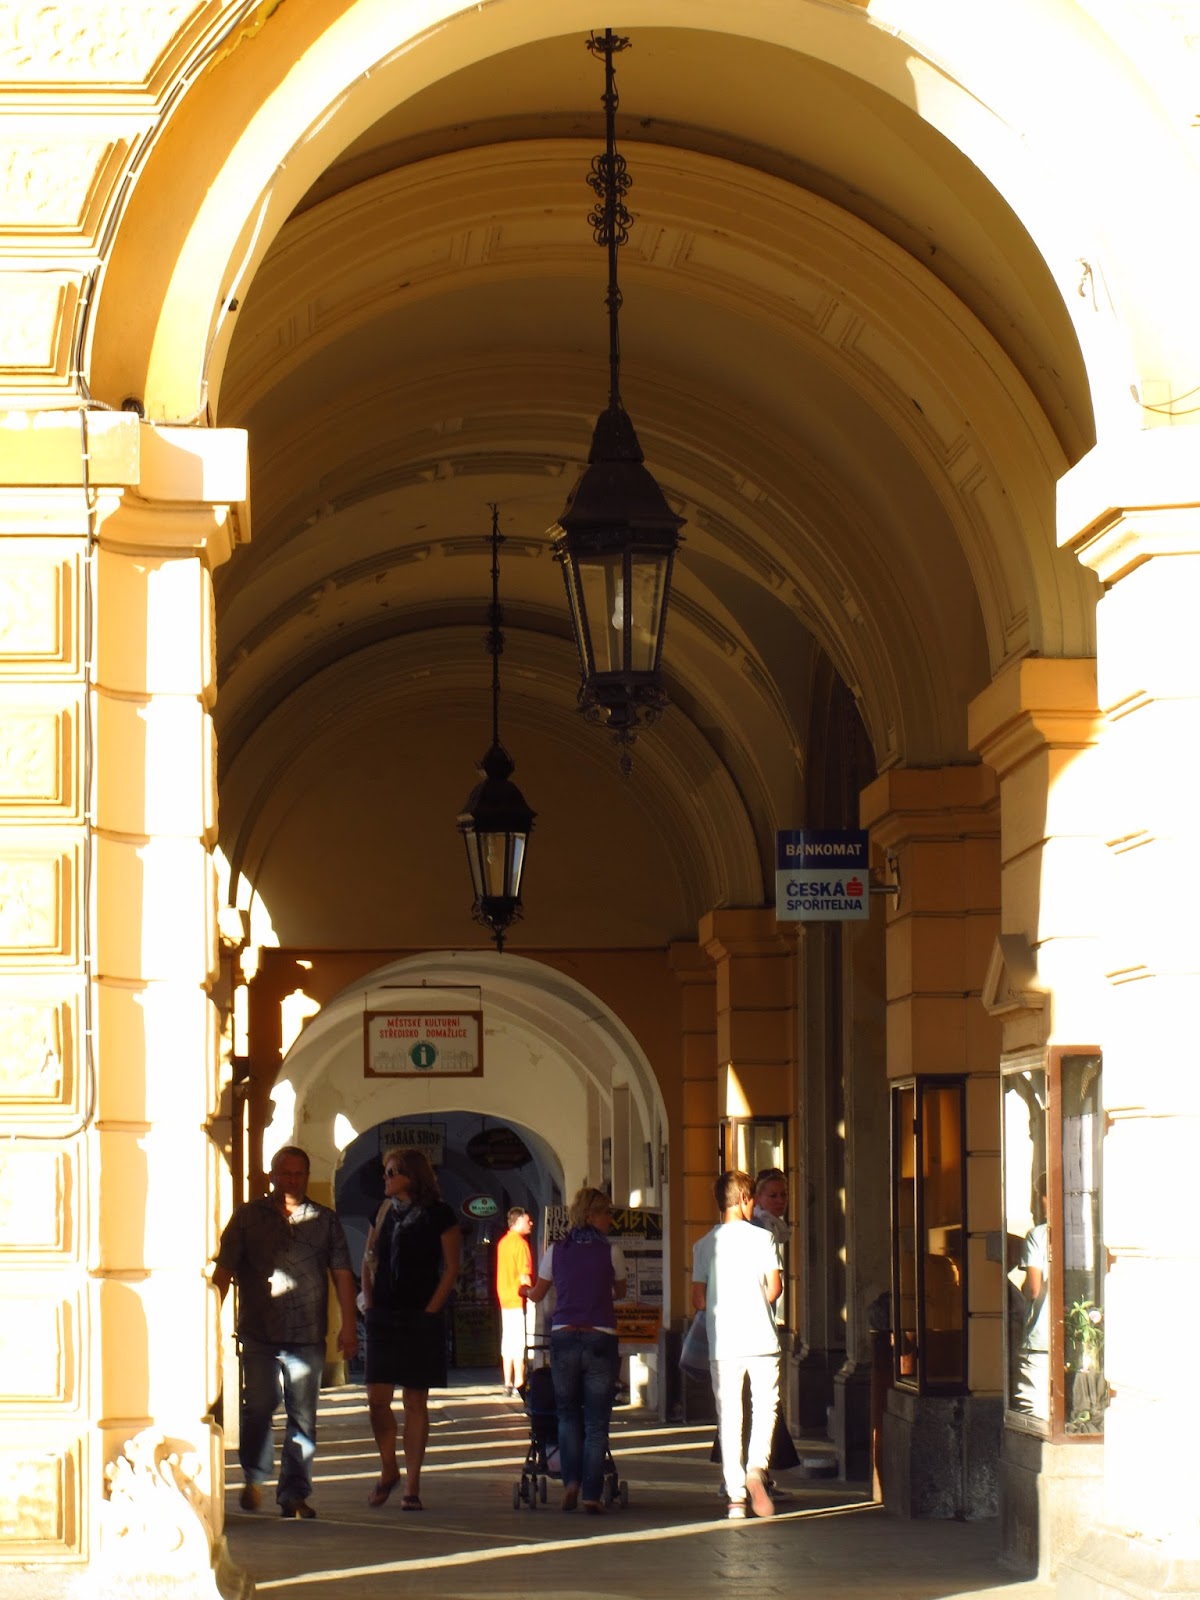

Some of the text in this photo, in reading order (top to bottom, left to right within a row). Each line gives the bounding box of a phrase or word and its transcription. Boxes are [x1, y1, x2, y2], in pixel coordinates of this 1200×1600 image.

[785, 844, 862, 856] BANKOMAT
[786, 879, 845, 897] ČESKÁ
[786, 897, 863, 911] SPOŘITELNA
[387, 1017, 460, 1028] MĚSTSKÉ KULTURNÍ
[379, 1028, 467, 1039] STŘEDISKO DOMAŽLICE
[384, 1128, 441, 1145] TABÁK SHOP
[548, 1228, 568, 1241] FES
